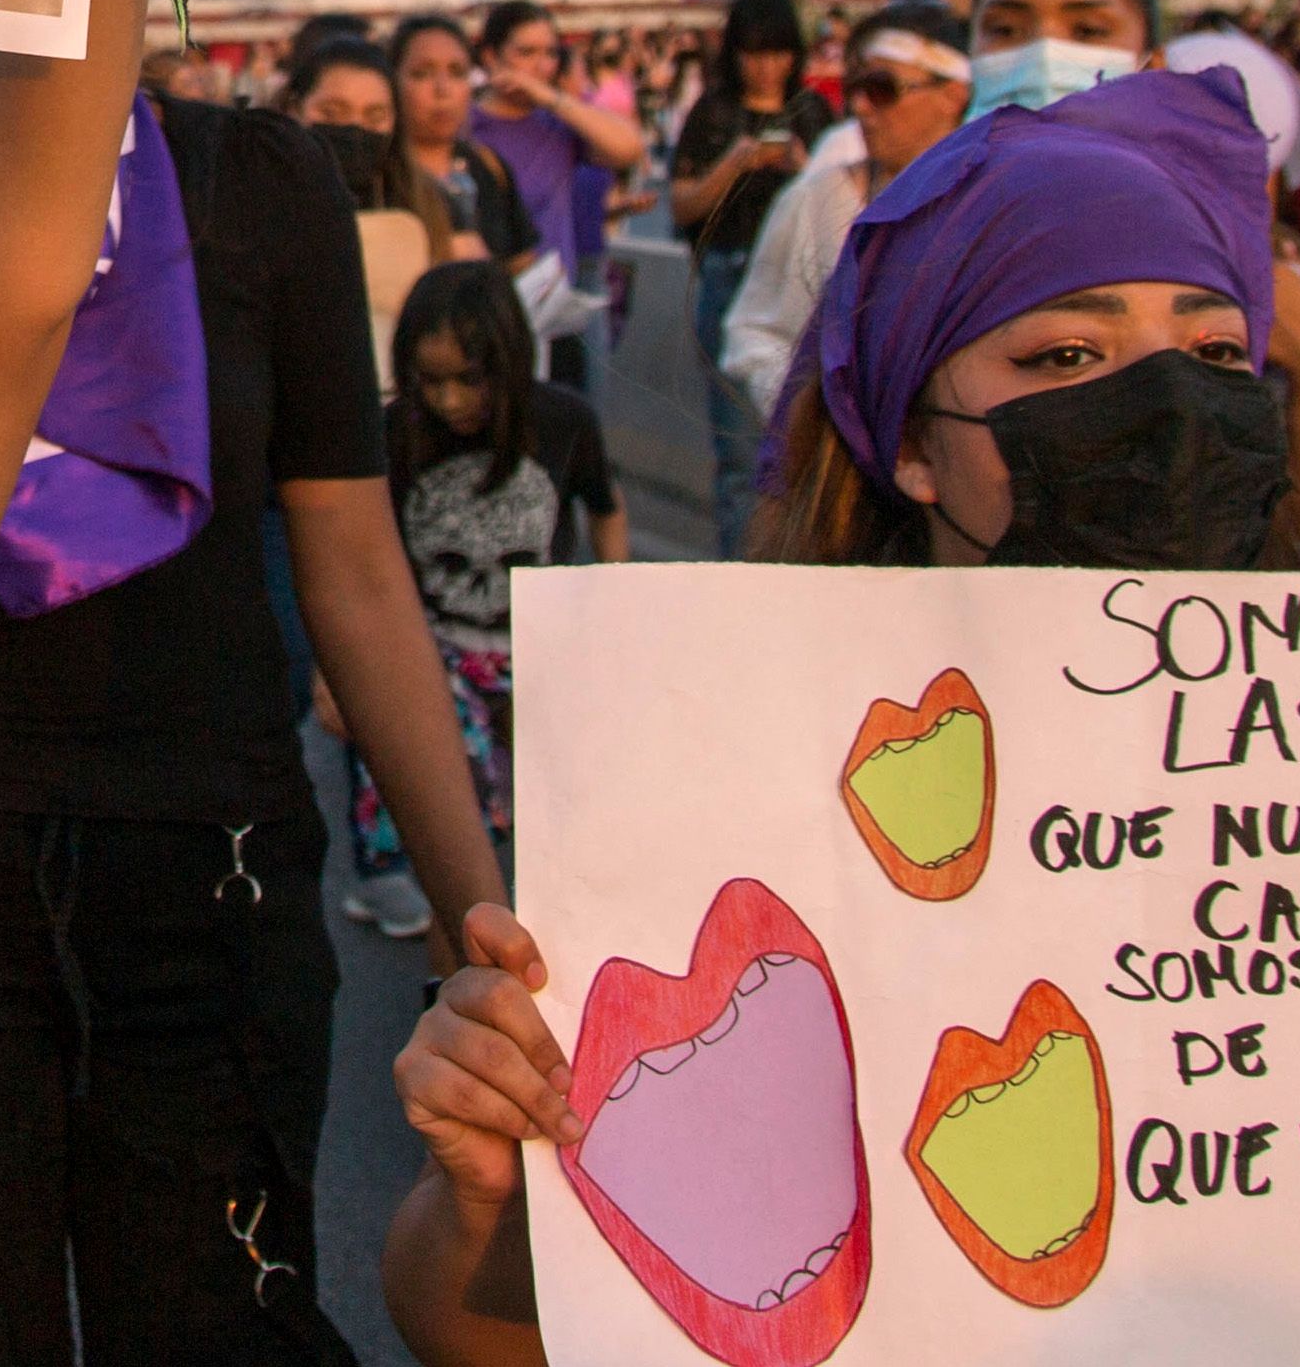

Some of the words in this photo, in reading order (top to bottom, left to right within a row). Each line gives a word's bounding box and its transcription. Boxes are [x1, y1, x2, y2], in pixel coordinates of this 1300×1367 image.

[1030, 804, 1174, 873] QUE
[1172, 1022, 1267, 1086] DE
[1125, 1117, 1280, 1206] QUE
